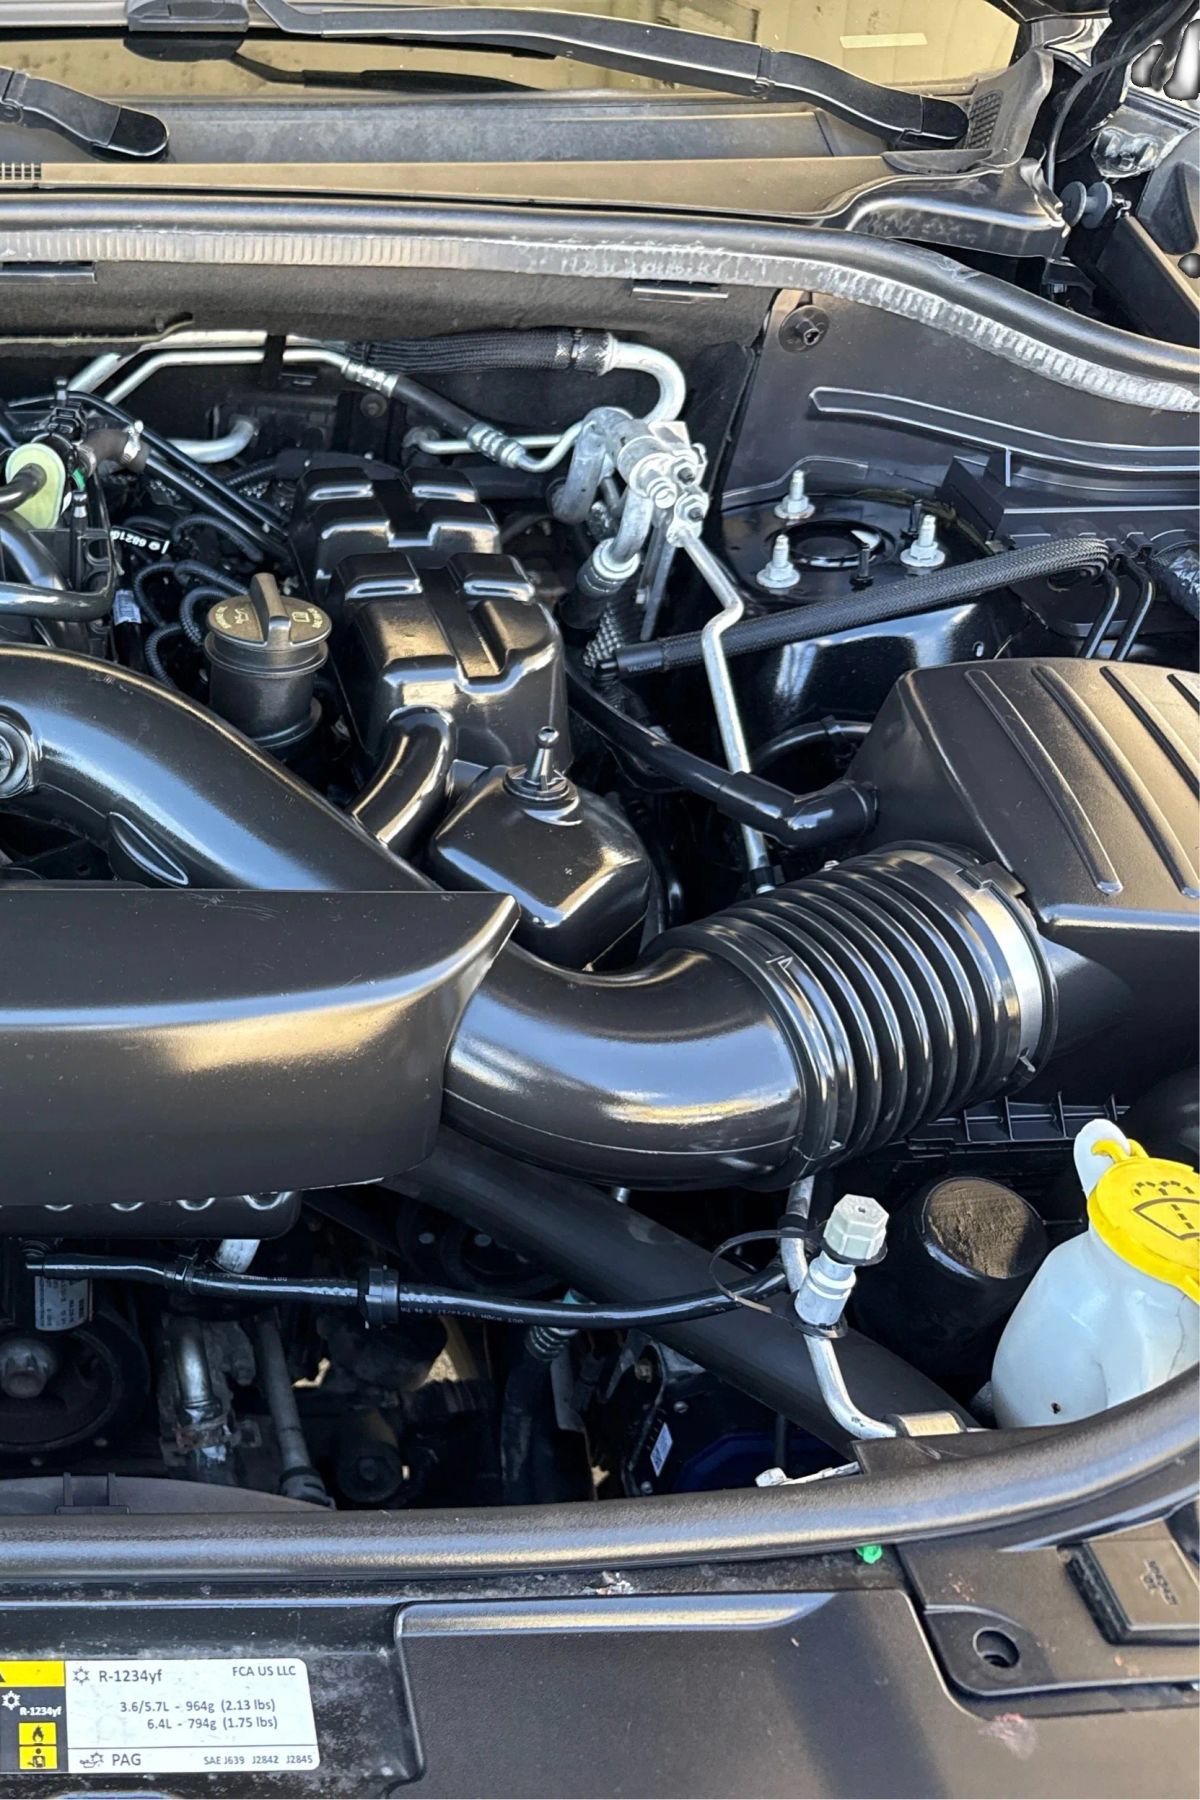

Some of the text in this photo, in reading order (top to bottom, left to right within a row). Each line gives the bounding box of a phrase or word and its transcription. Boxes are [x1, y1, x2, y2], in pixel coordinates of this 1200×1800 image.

[99, 1669, 163, 1685] R-1234yf
[233, 1665, 296, 1677] FCA US LLC
[19, 1706, 63, 1718] R-1234yf
[120, 1701, 170, 1714] 3.6/5.7L
[186, 1701, 215, 1714] 964g
[221, 1699, 250, 1713] (2.13
[254, 1698, 276, 1712] lbs)
[147, 1718, 172, 1730] 6.4L
[189, 1718, 217, 1731] 794g
[223, 1716, 253, 1730] (1.75
[256, 1715, 278, 1729] lbs)
[111, 1753, 142, 1767] PAG
[203, 1754, 313, 1766] SAE J639 J2842 J2845
